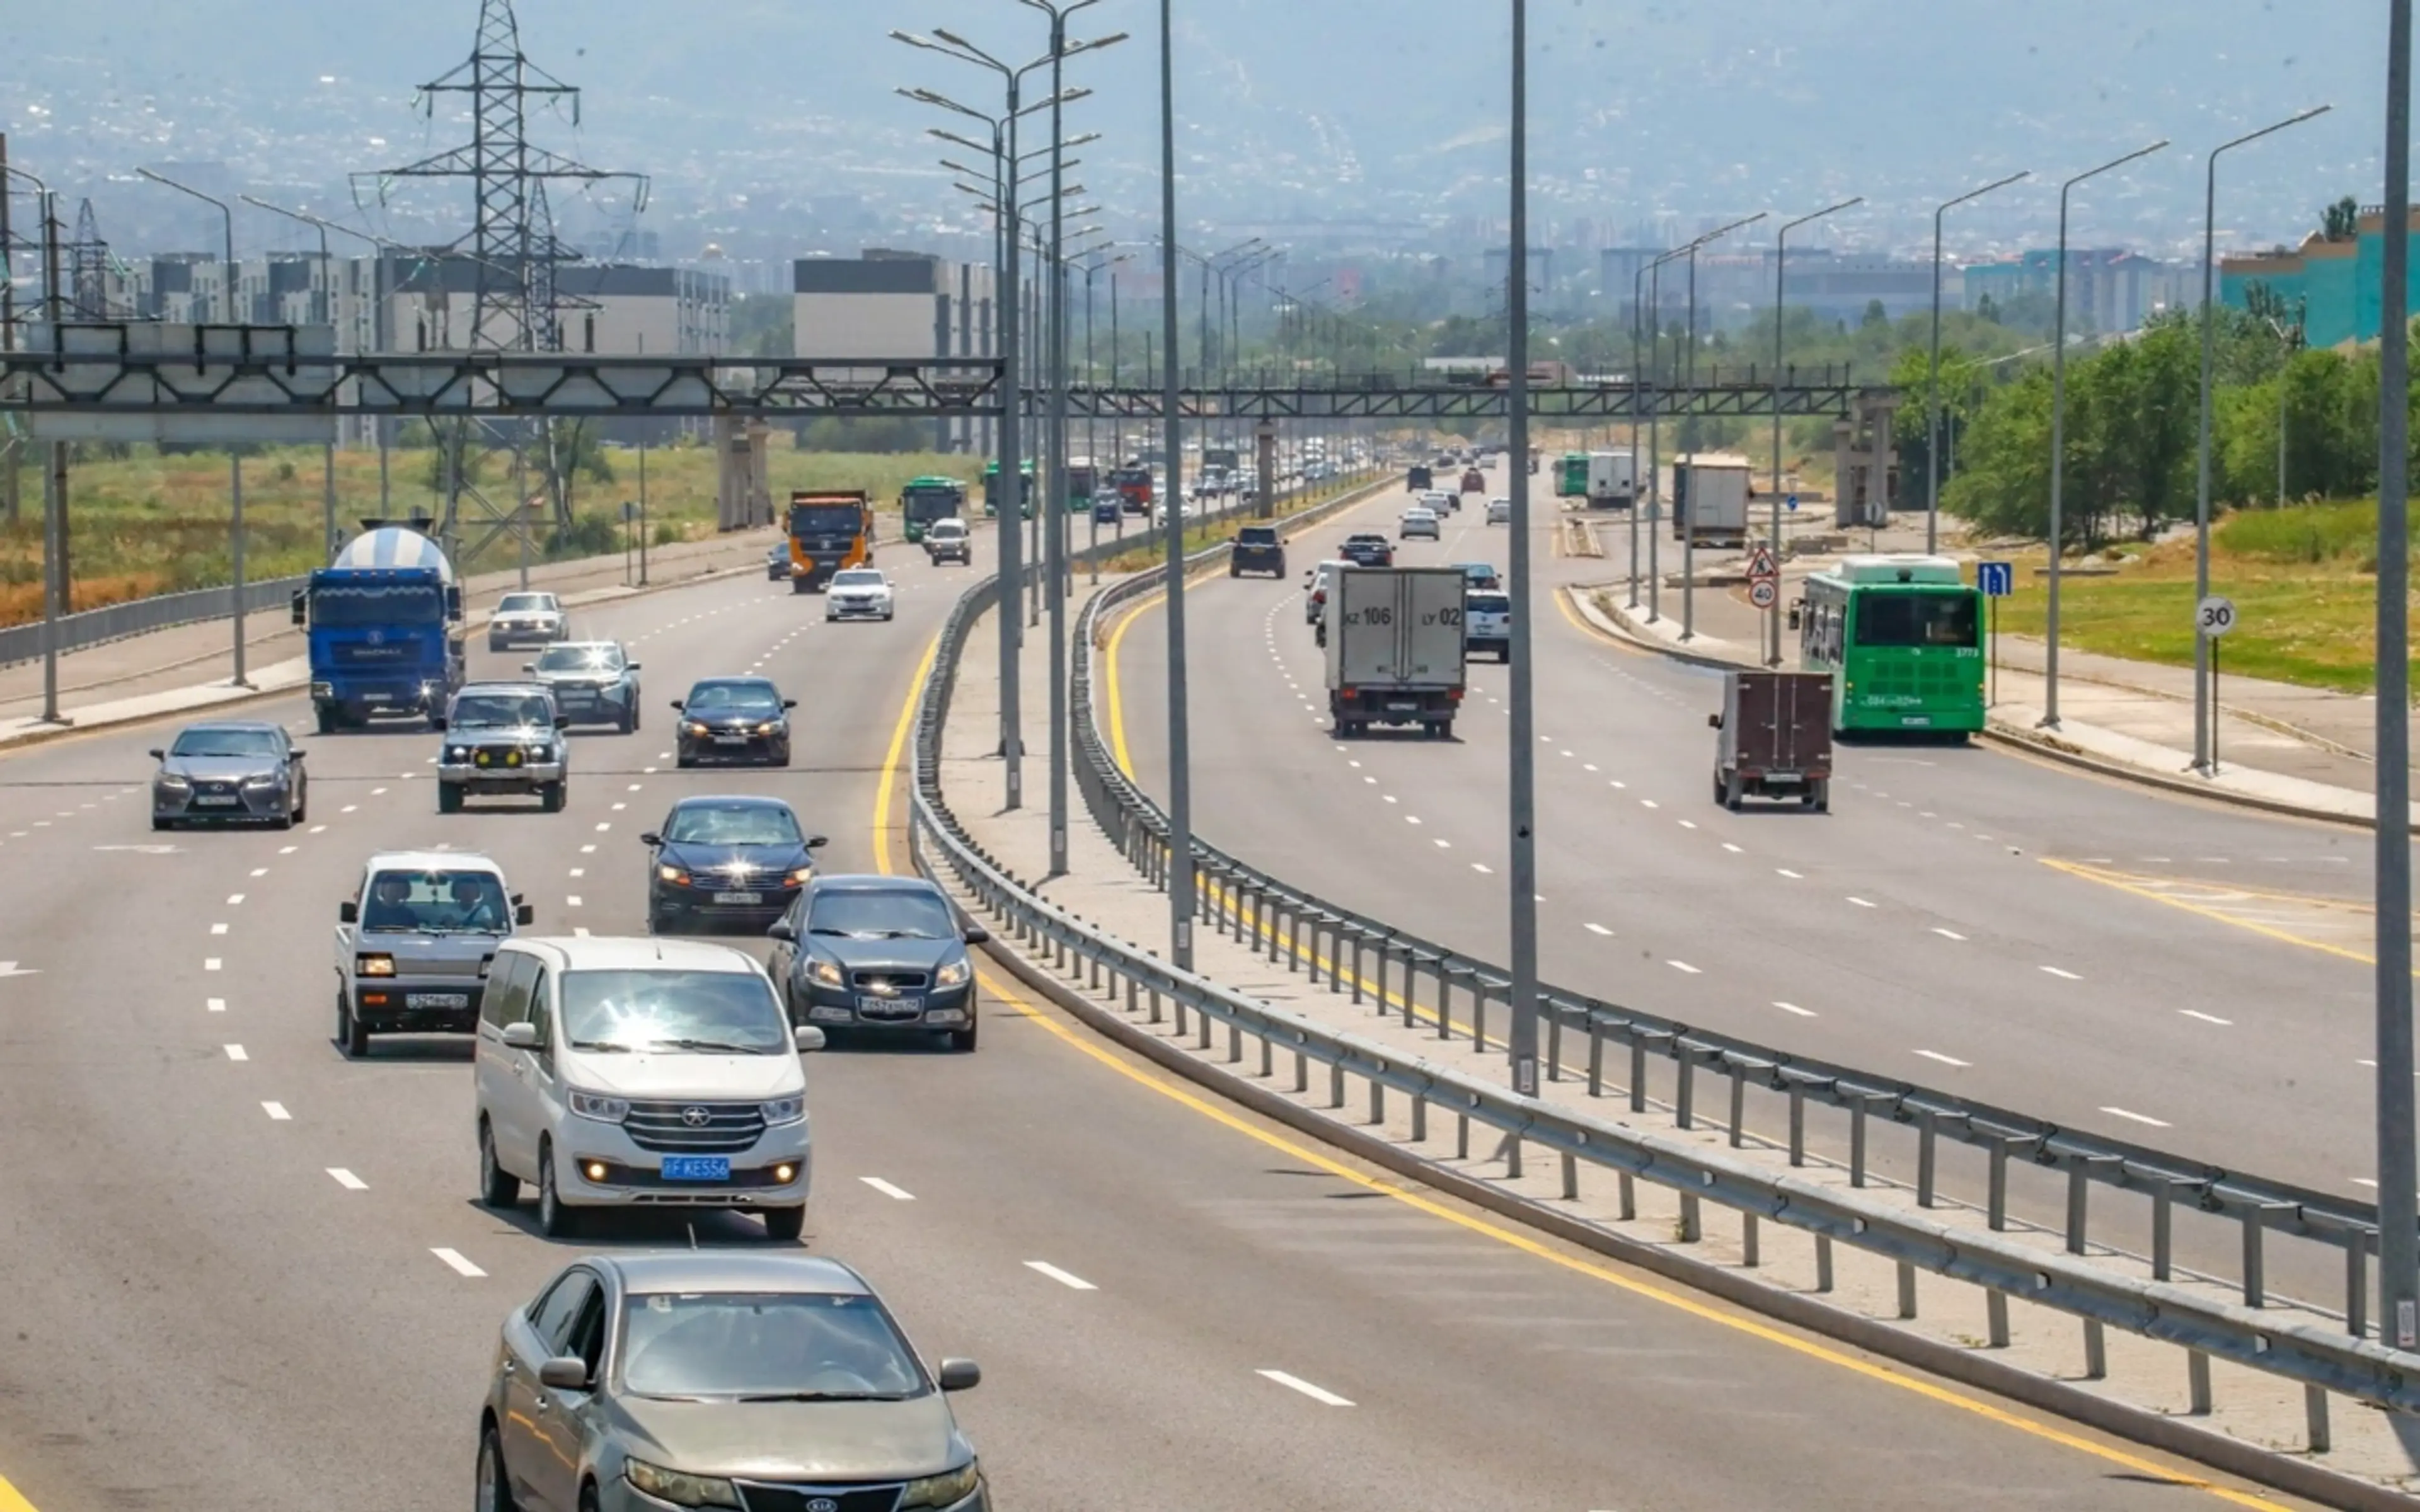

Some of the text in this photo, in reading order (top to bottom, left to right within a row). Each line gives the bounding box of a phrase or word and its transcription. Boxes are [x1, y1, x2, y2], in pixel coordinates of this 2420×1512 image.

[1754, 587, 1772, 599] 40
[1363, 607, 1392, 626] 106
[1422, 613, 1436, 626] LY
[1439, 607, 1461, 626] 02
[2203, 607, 2230, 626] 30
[812, 1501, 832, 1510] KIA
